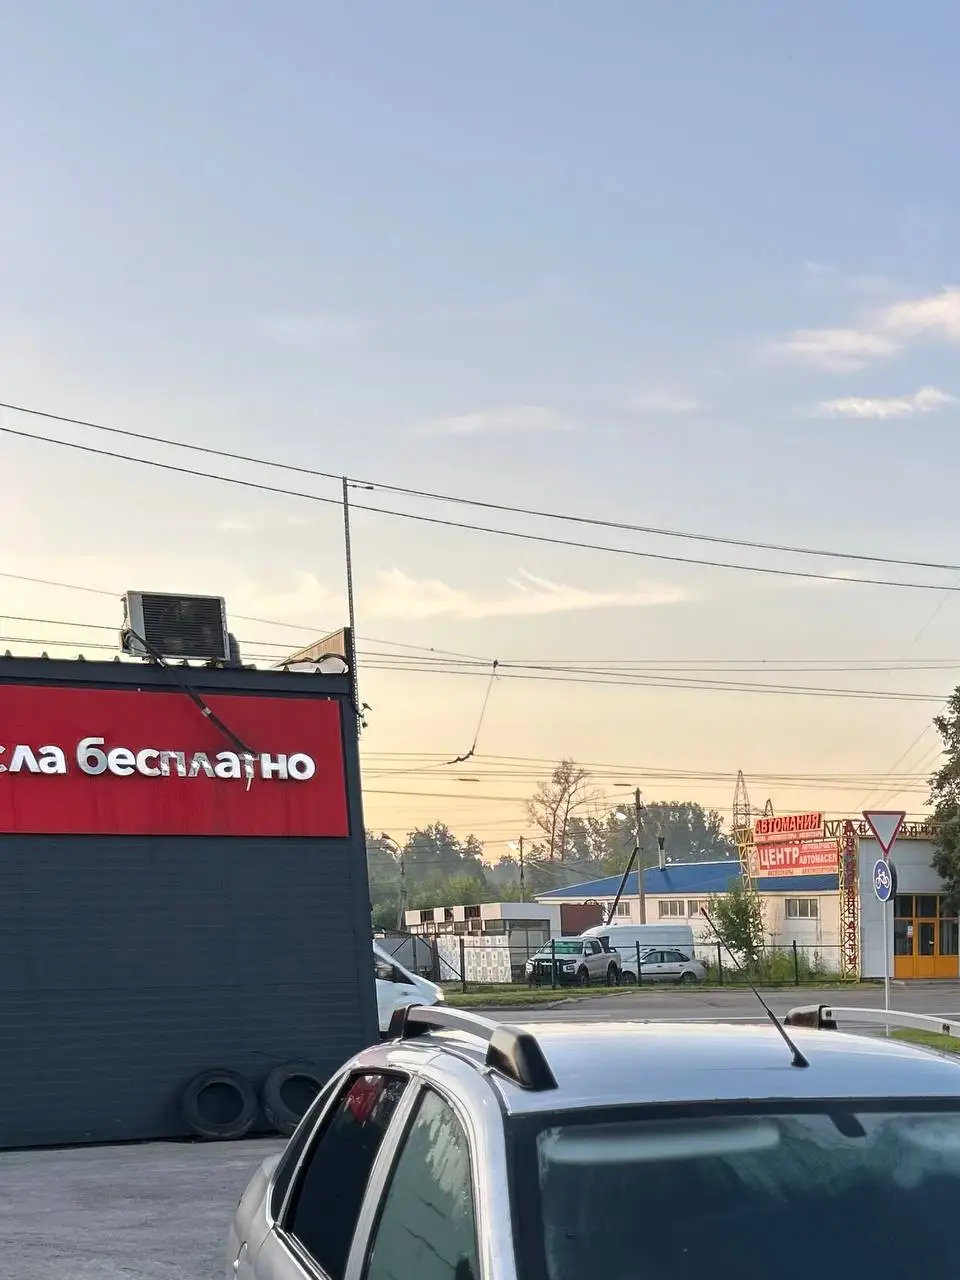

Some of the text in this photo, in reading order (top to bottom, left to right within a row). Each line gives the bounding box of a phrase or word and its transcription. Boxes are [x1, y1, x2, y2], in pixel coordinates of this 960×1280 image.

[76, 737, 316, 781] бесплатно
[755, 813, 822, 834] АВТОМАНИЯ
[760, 846, 800, 869] ЦЕНТР
